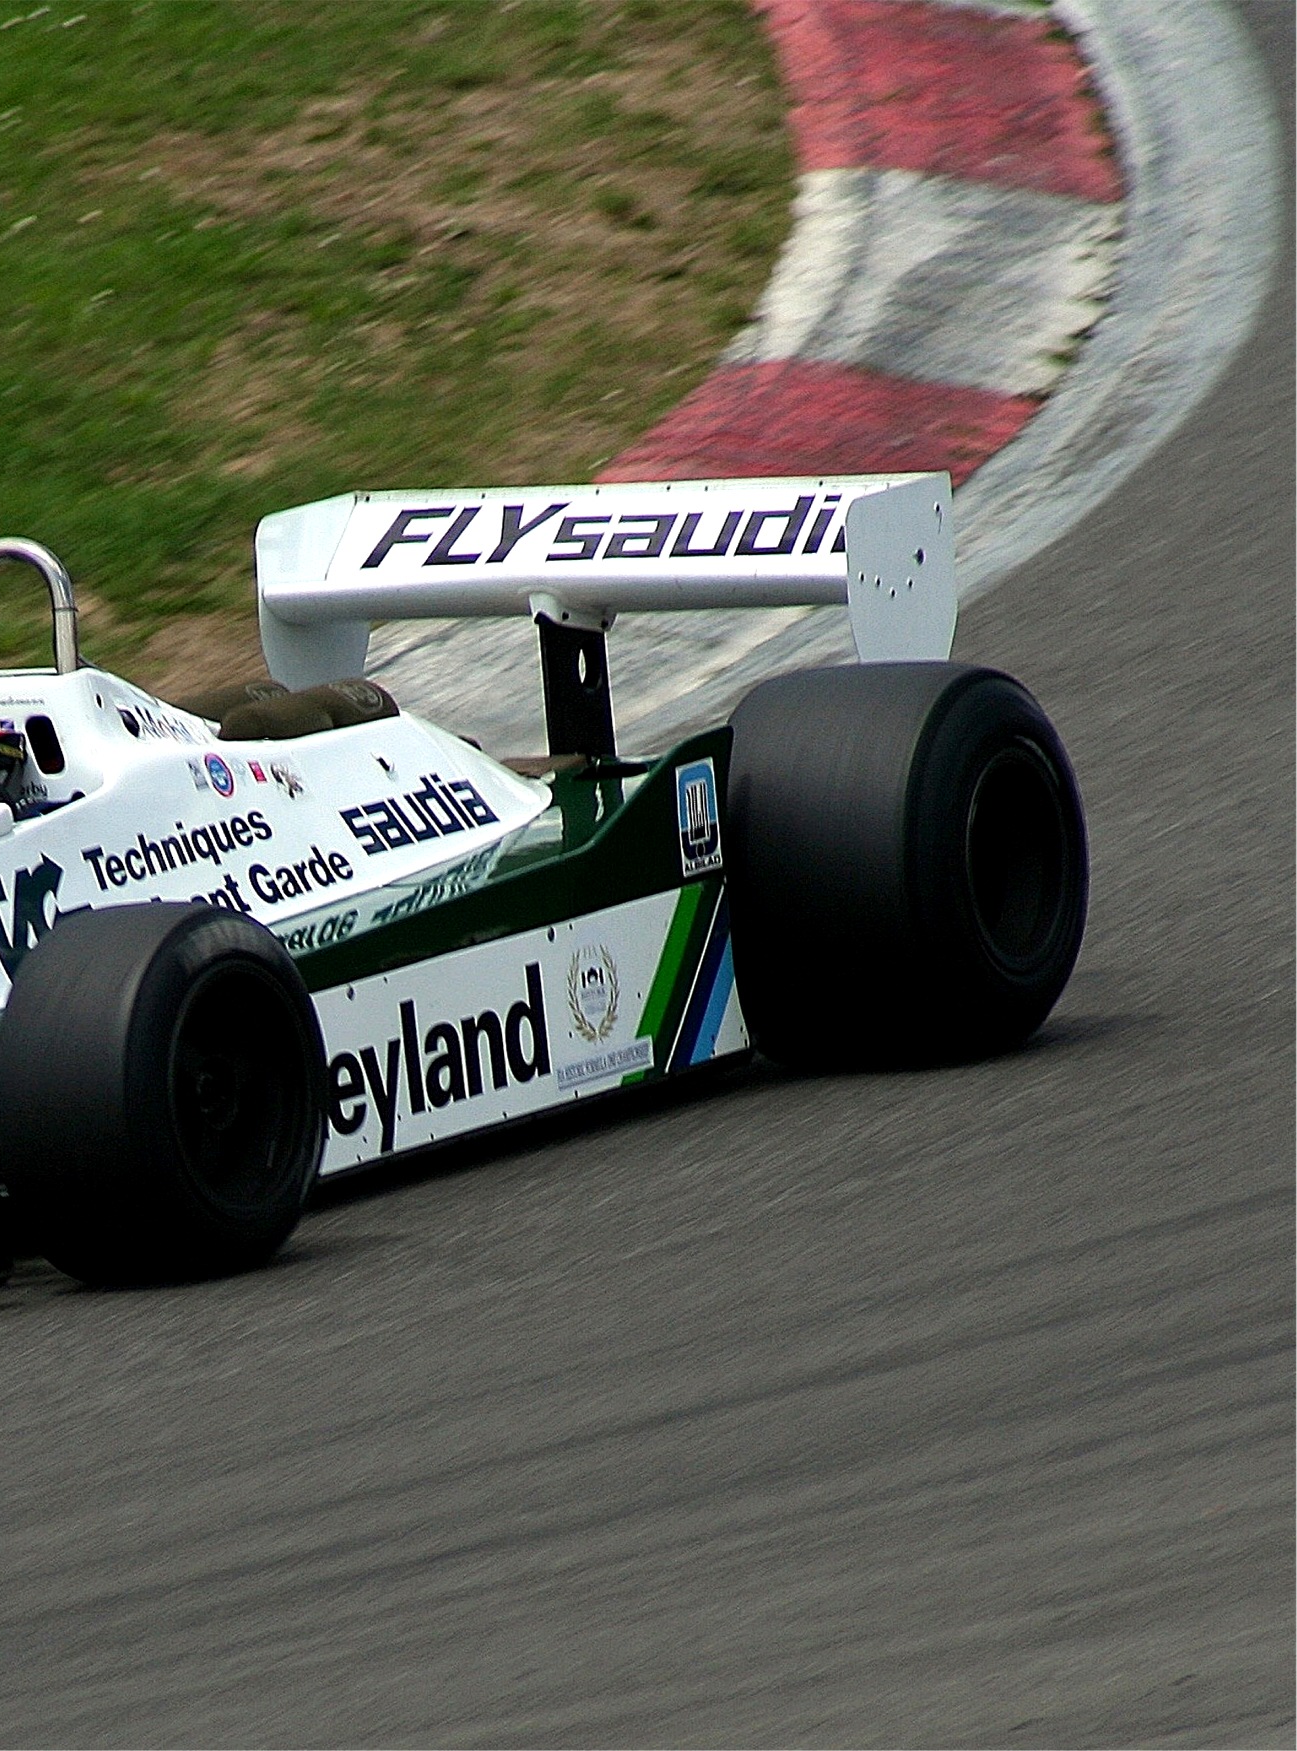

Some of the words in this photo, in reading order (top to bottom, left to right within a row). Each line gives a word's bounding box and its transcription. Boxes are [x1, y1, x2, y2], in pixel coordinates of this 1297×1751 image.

[361, 493, 848, 570] FLYsaudi
[82, 809, 273, 892] Techniques
[340, 774, 501, 856] saudia
[249, 846, 354, 904] Garde
[326, 961, 552, 1156] eyland
